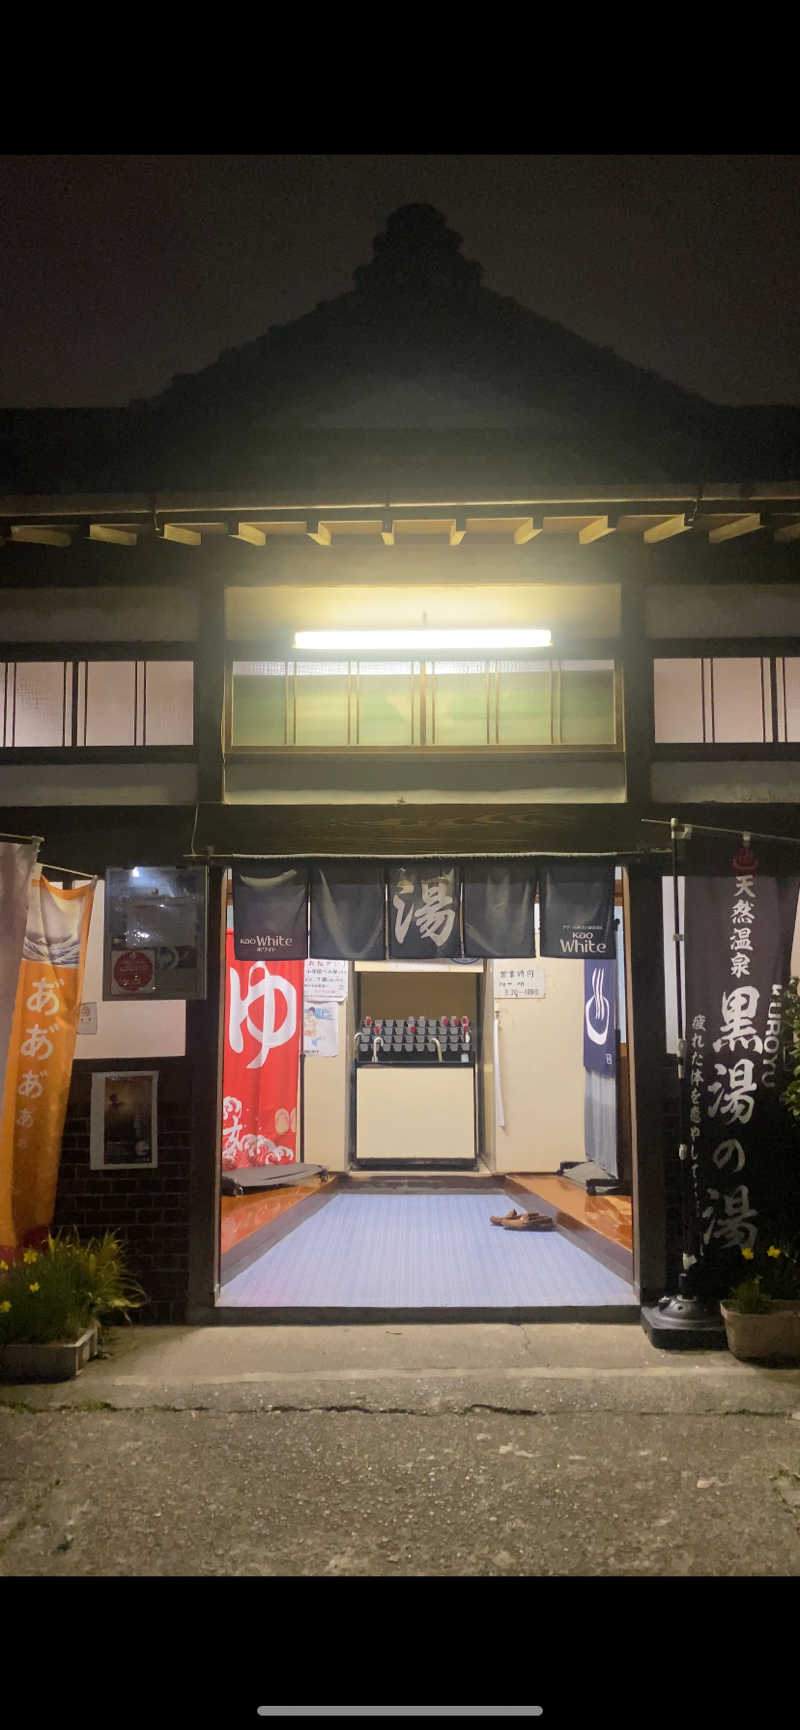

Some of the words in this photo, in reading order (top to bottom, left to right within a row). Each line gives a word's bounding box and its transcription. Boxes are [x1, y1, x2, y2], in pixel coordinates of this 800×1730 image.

[256, 935, 293, 947] White
[560, 939, 607, 953] White
[729, 875, 755, 978] 天然温泉
[229, 961, 297, 1069] ゆ
[761, 984, 783, 1088] KUROYU
[702, 985, 763, 1253] 黒湯の湯
